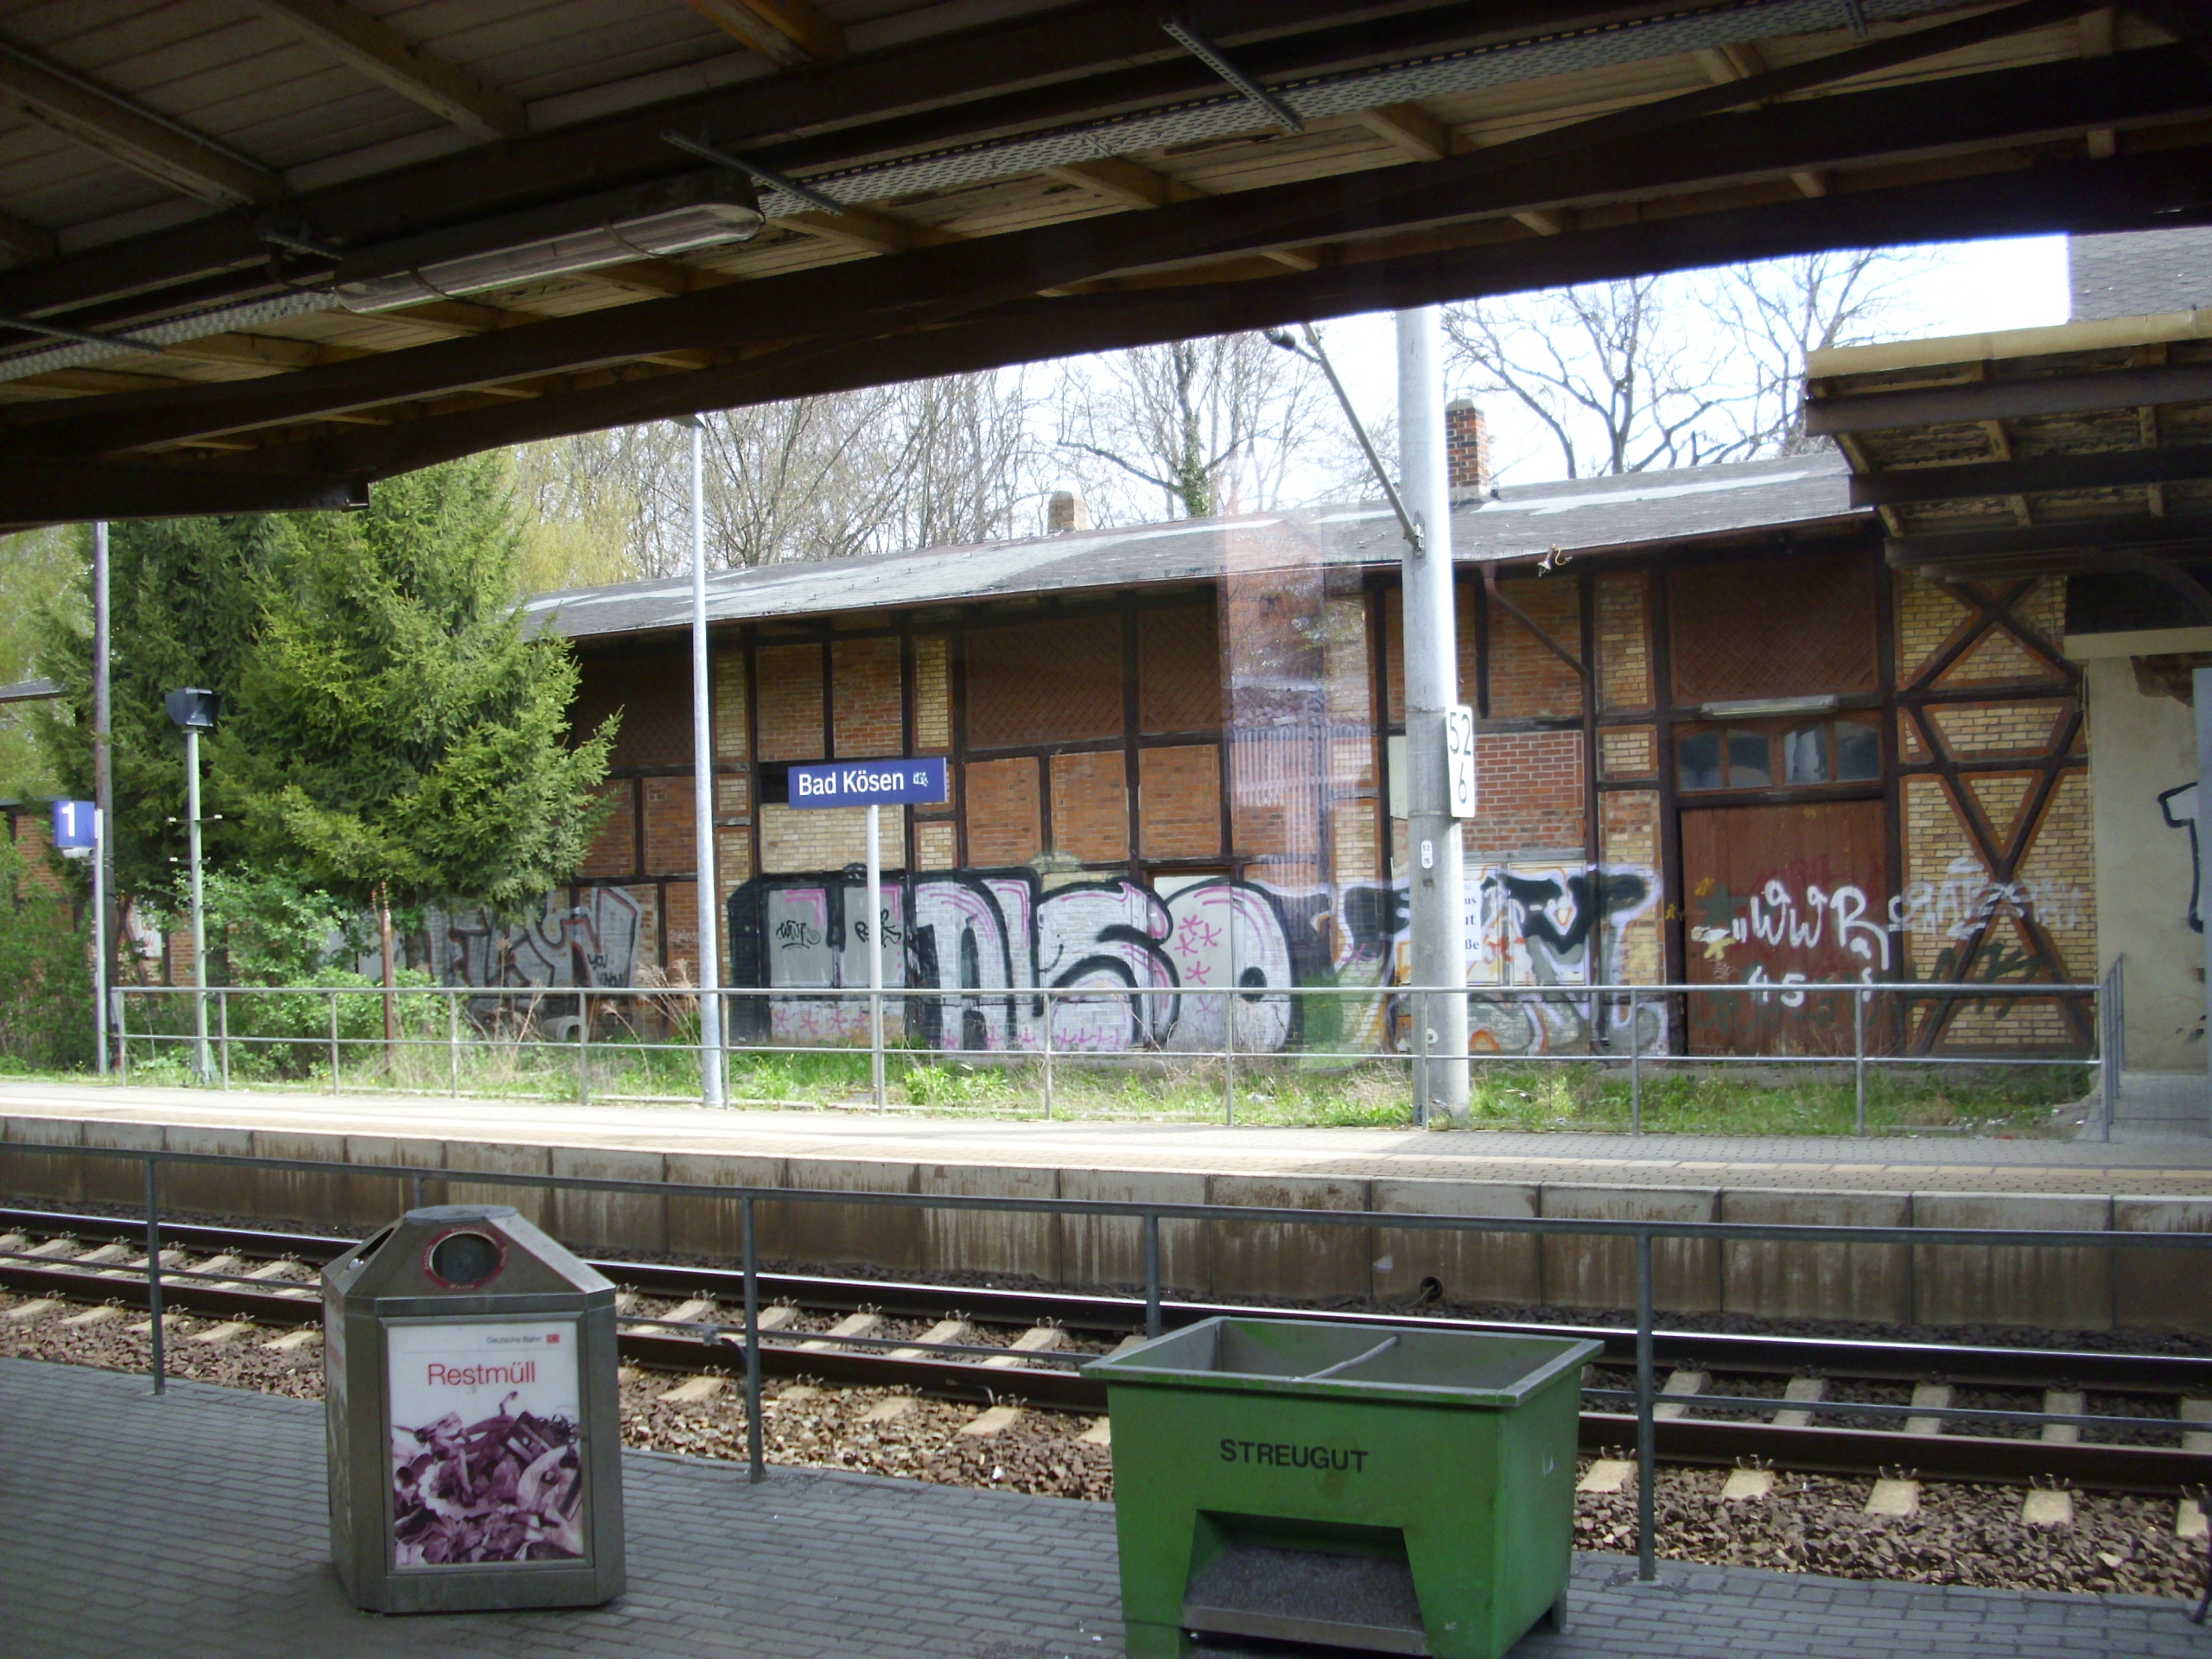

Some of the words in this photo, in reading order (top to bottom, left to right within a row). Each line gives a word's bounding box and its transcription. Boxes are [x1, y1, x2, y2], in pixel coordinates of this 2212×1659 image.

[1449, 712, 1471, 757] 52
[798, 772, 837, 796] Bad
[843, 769, 905, 793] Kösen
[1458, 762, 1467, 805] 6
[61, 801, 76, 837] 1
[428, 1361, 536, 1386] Restmüll
[1219, 1438, 1369, 1473] STREUGUT
